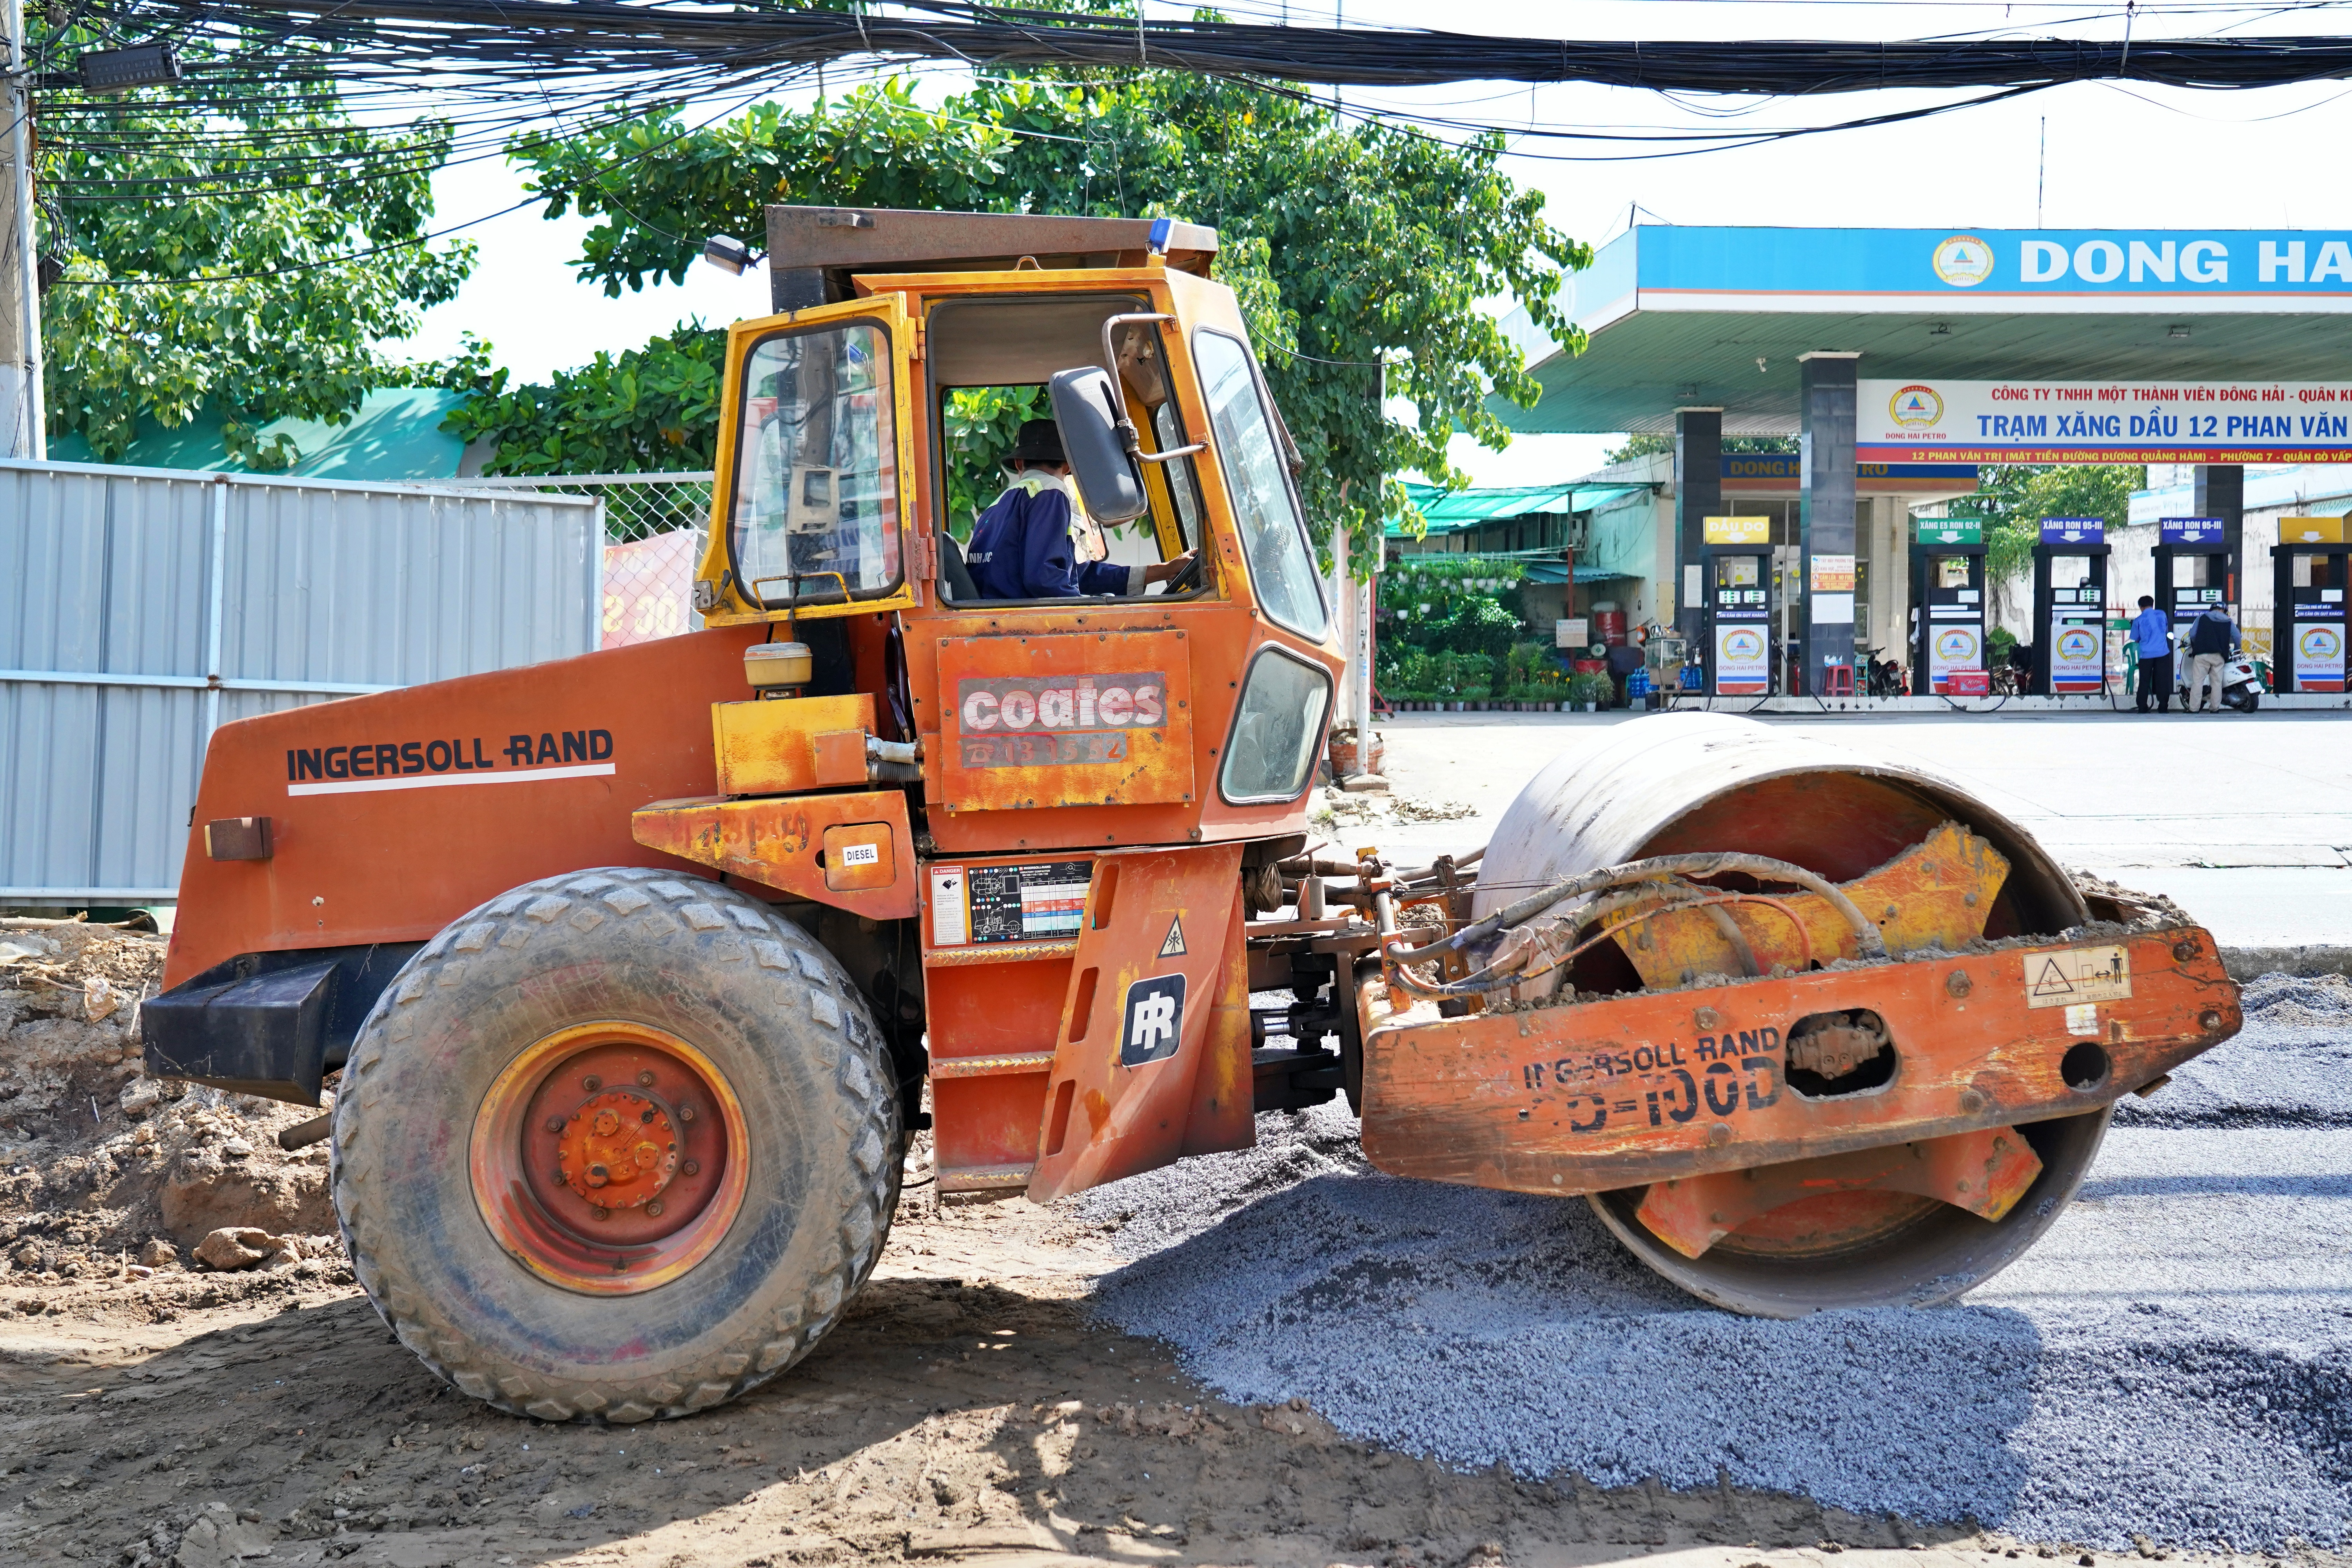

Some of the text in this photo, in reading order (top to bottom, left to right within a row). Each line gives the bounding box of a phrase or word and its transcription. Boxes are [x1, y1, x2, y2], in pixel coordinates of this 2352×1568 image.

[2020, 240, 2228, 283] DONG
[1992, 385, 2029, 401] CÔNG
[2033, 388, 2051, 401] TY
[2056, 388, 2093, 401] TNHH
[2098, 386, 2127, 403] MỘT
[2132, 386, 2179, 401] THÀNH
[2184, 386, 2215, 401] VIÊN
[2220, 386, 2257, 401] ĐÔNG
[2262, 385, 2285, 401] HẢI
[2299, 386, 2335, 403] QUÂN
[1977, 406, 2347, 442] TRẠM XĂNG DẦU 12 PHAN VĂN
[1912, 452, 1925, 461] 12
[1928, 452, 1957, 461] PHAN
[1960, 451, 1982, 461] VĂN
[1984, 452, 2002, 462] TRỊ
[2005, 451, 2031, 463] (MẶT
[2035, 449, 2059, 461] TIỀN
[2062, 450, 2099, 461] ĐƯỜNG
[2102, 451, 2138, 461] DƯƠNG
[2141, 449, 2176, 462] QUẢNG
[2179, 450, 2206, 462] HÀM)
[2220, 451, 2263, 461] PHƯỜNG
[2266, 453, 2272, 461] 7
[2283, 451, 2311, 463] QUẬN
[2314, 451, 2328, 461] GÒ
[2331, 450, 2352, 461] VẤP
[1730, 461, 1789, 475] DONG
[1743, 522, 1764, 532] DO
[1920, 520, 1938, 530] XĂNG
[1940, 521, 1948, 530] E5
[1949, 521, 1964, 530] RON
[2043, 519, 2102, 530] XĂNG RON 95-III
[2163, 520, 2221, 530] XĂNG RON 95-III
[964, 677, 1163, 730] coates
[1003, 741, 1034, 763] 13
[1047, 740, 1078, 761] 15
[287, 737, 494, 781] INGERSOLL
[847, 849, 875, 861] DIESEL
